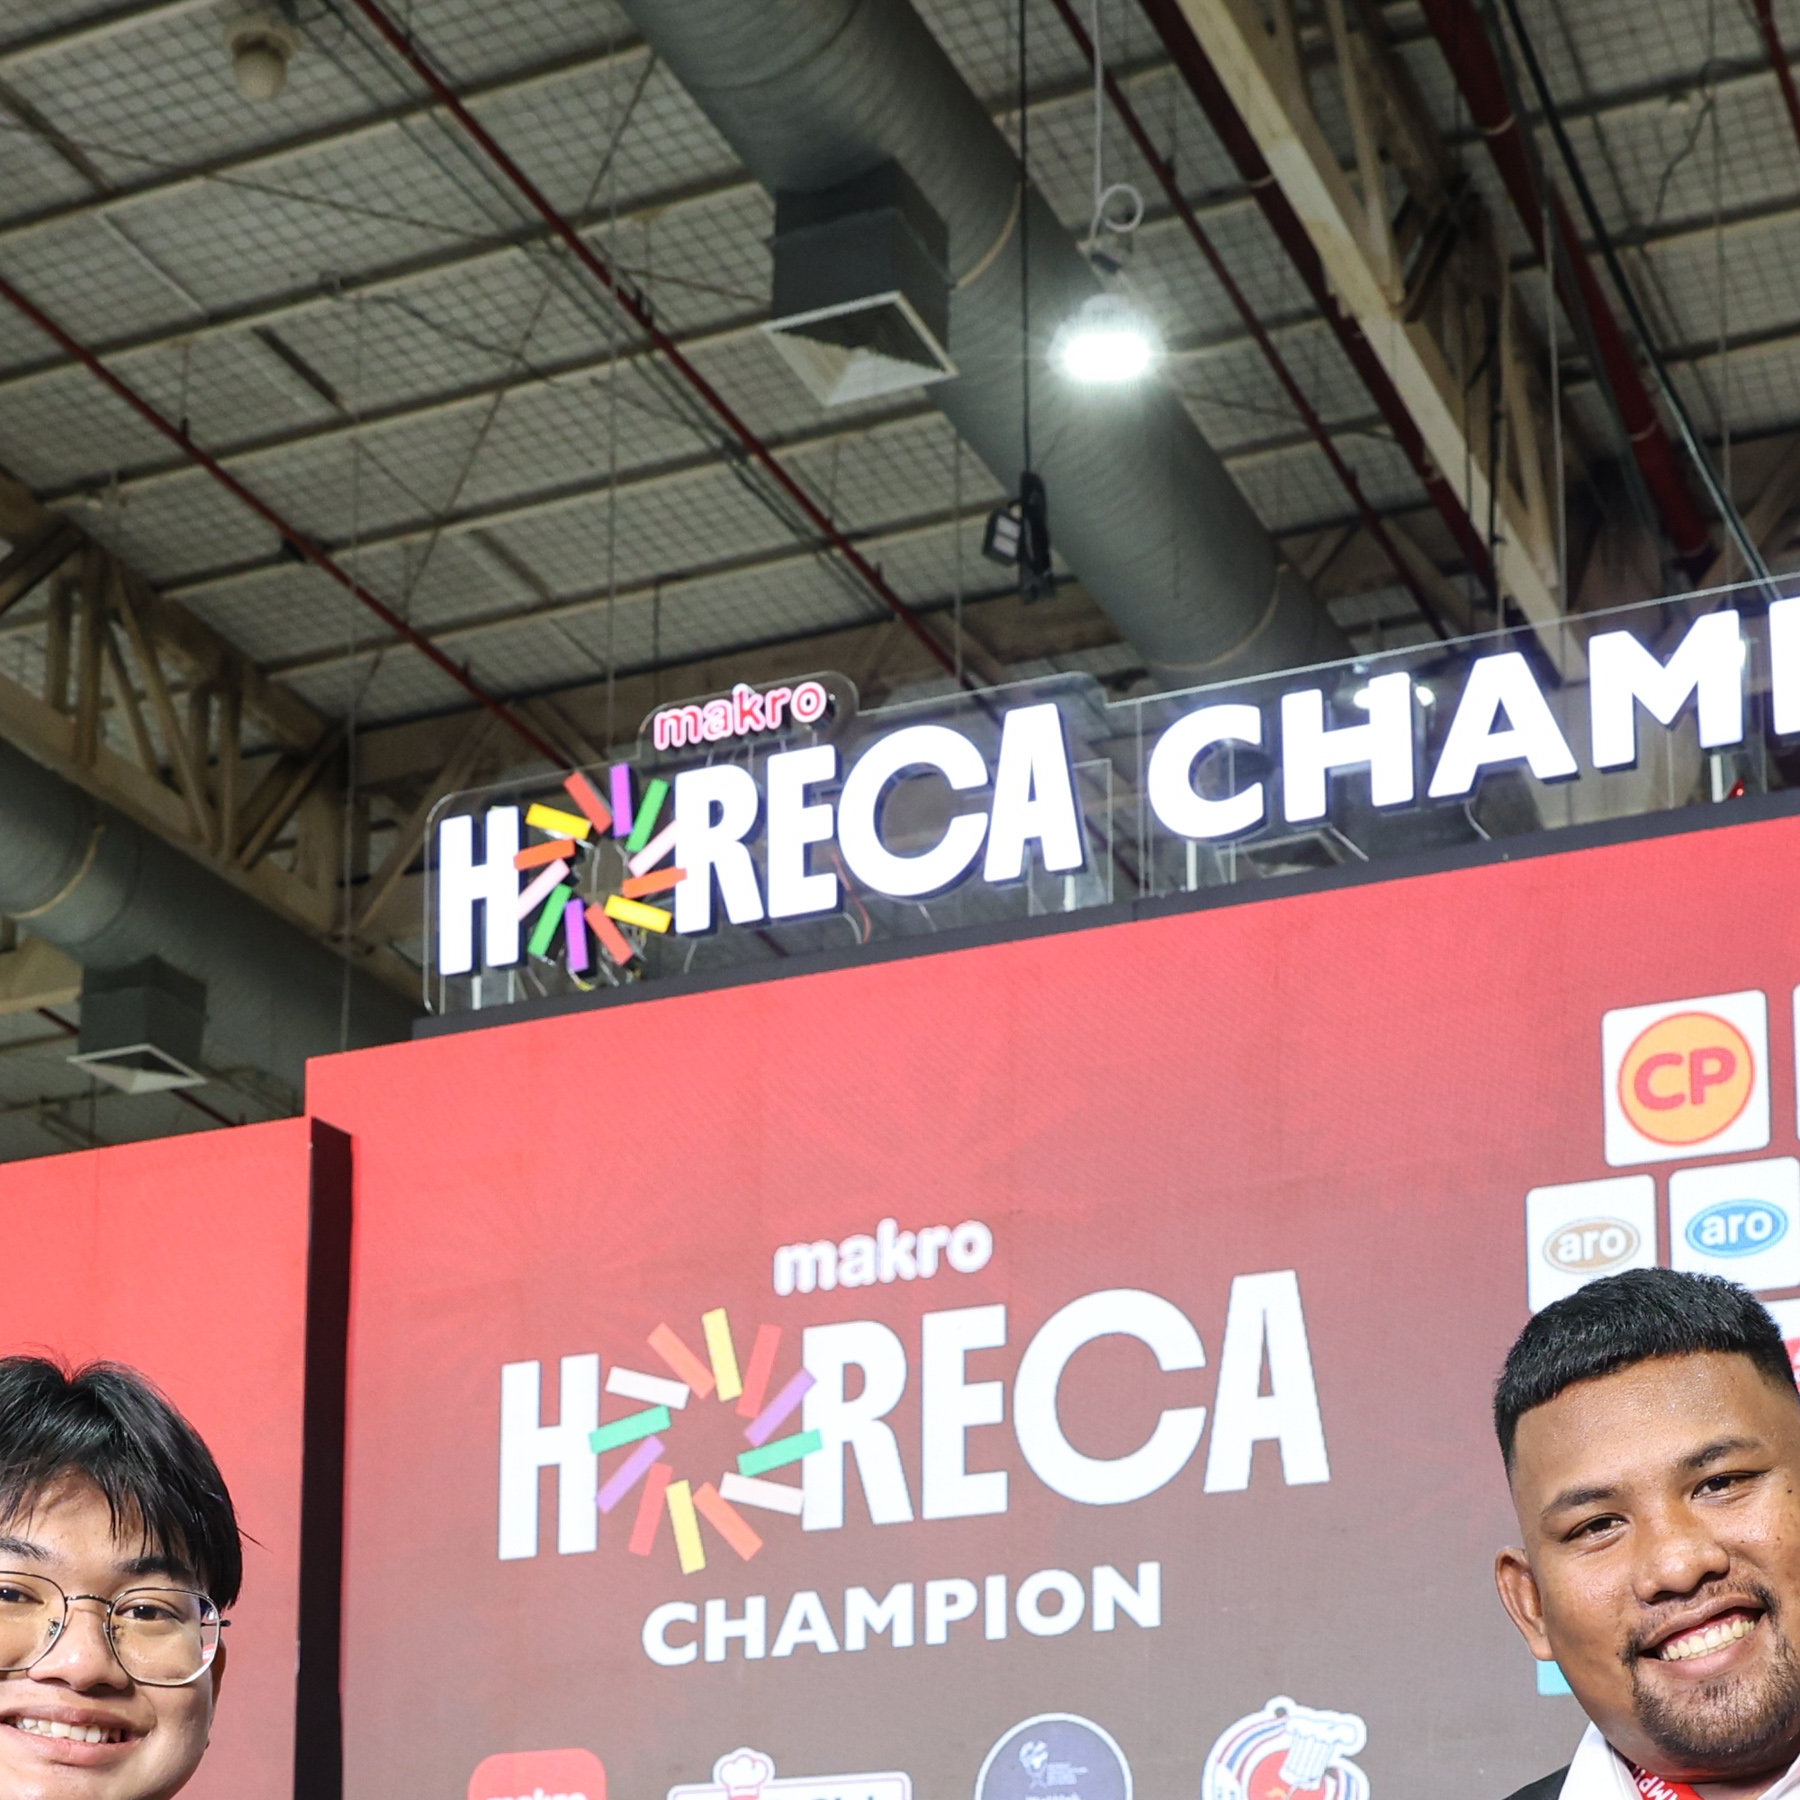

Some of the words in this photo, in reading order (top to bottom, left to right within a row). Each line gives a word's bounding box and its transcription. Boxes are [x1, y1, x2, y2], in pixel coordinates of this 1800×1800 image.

[649, 676, 830, 751] makro
[436, 699, 1086, 978] HORECA
[1634, 1046, 1736, 1111] CP
[773, 1219, 993, 1294] makro
[1557, 1232, 1626, 1263] aro
[1701, 1211, 1773, 1244] aro
[498, 1269, 1330, 1574] HORECA
[642, 1562, 1162, 1667] CHAMPION
